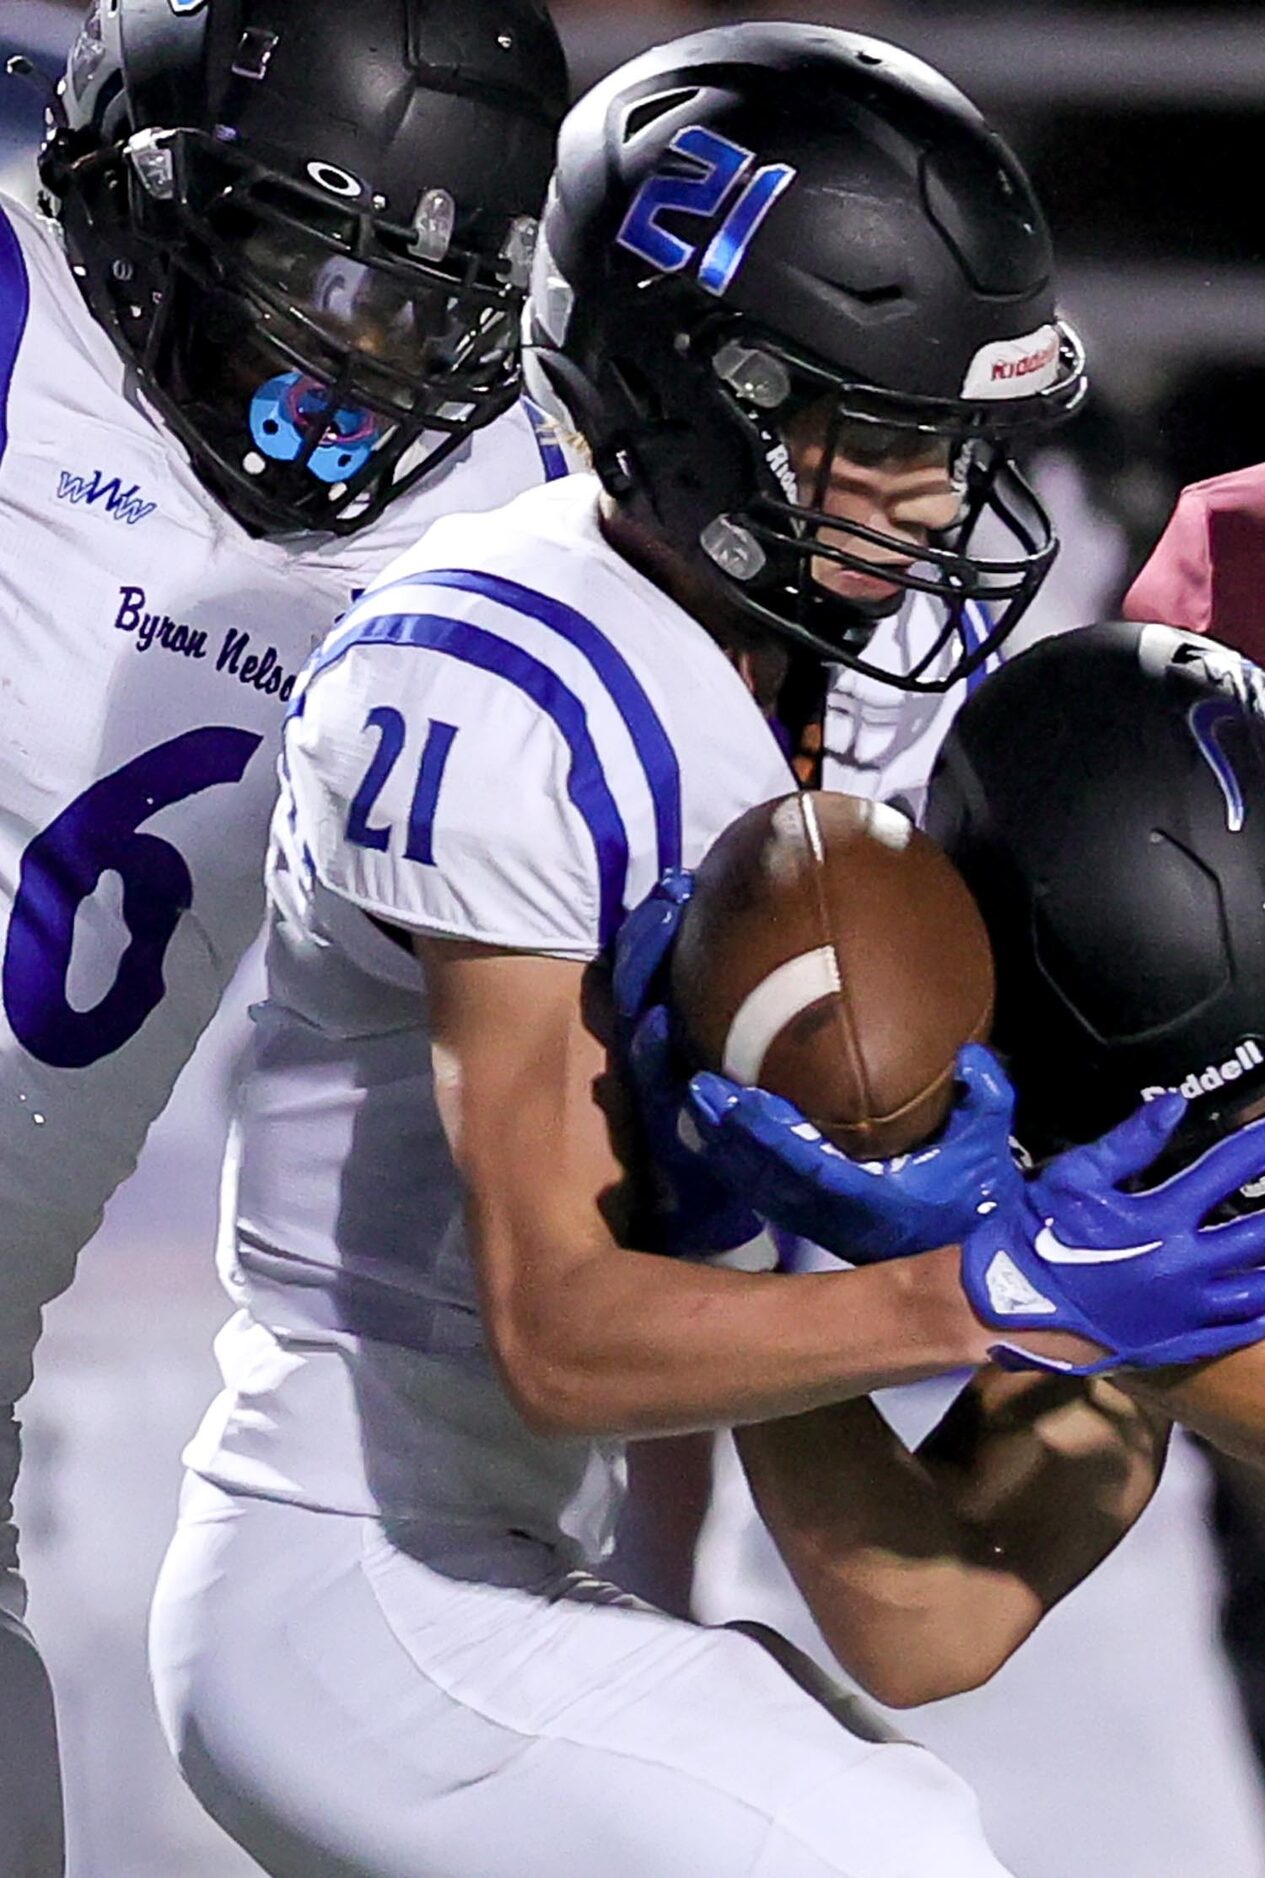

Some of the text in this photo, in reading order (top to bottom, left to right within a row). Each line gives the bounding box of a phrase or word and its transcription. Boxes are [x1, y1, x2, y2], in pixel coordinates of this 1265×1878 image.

[615, 125, 798, 297] 21
[114, 586, 298, 702] Byron Nelso
[343, 705, 460, 868] 21
[2, 726, 264, 1069] 6
[1140, 1040, 1264, 1102] ddell
